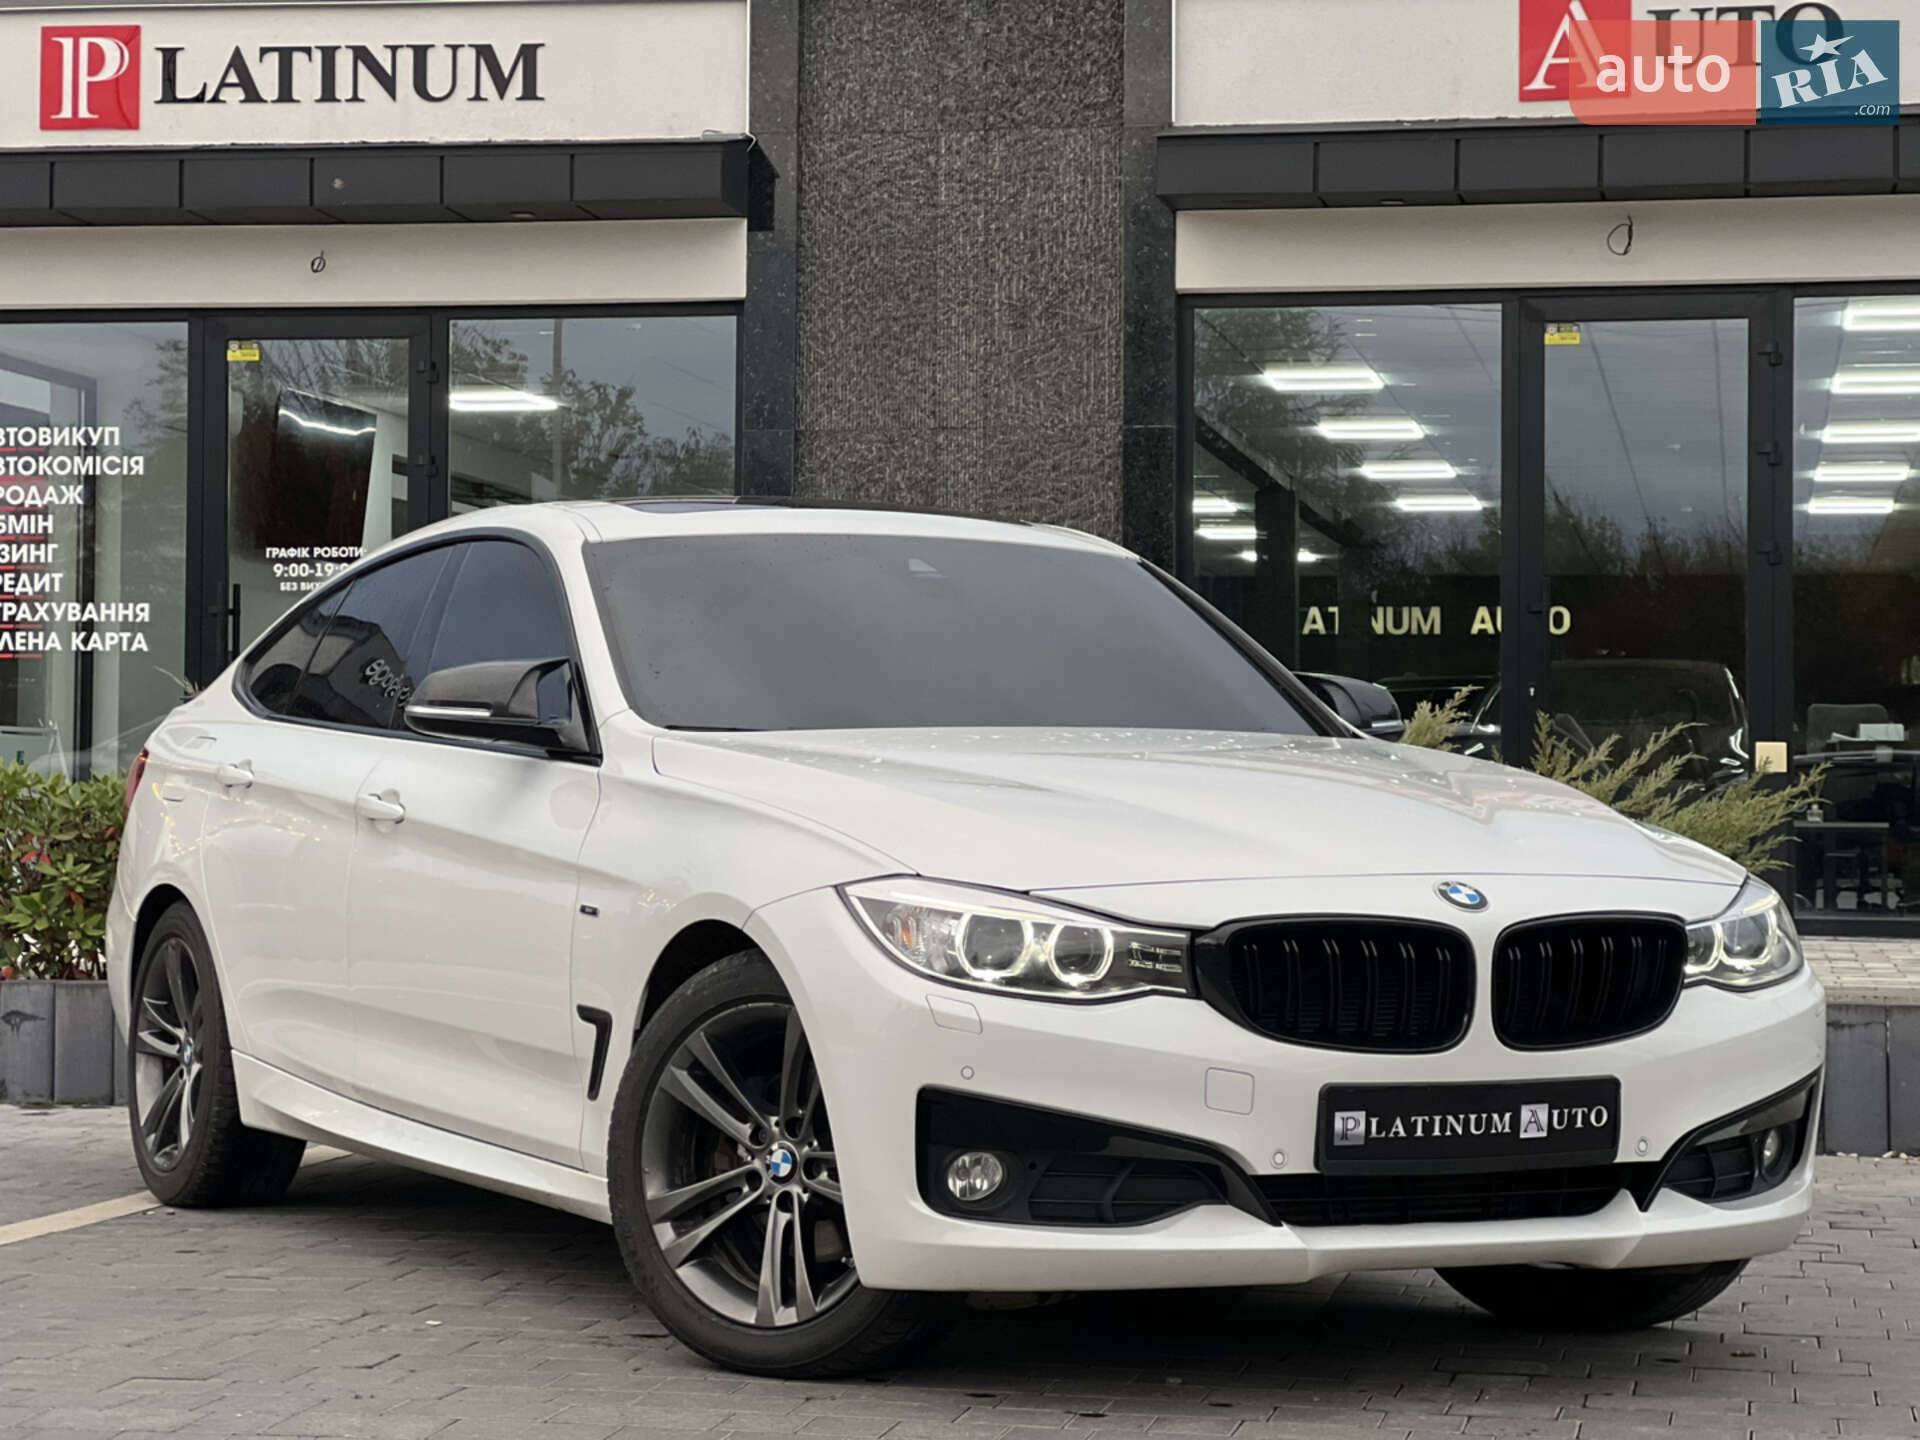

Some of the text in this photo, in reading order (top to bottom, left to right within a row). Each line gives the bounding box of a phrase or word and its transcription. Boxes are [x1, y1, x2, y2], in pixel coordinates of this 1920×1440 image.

[49, 36, 546, 120] PLATINUM
[265, 547, 310, 558] ГРАФІК
[0, 573, 63, 596] ЕДИТ
[0, 602, 150, 622] РАХУВАННЯ
[71, 631, 149, 652] КАРТА
[1338, 1105, 1609, 1142] PLATINUM AUTO
